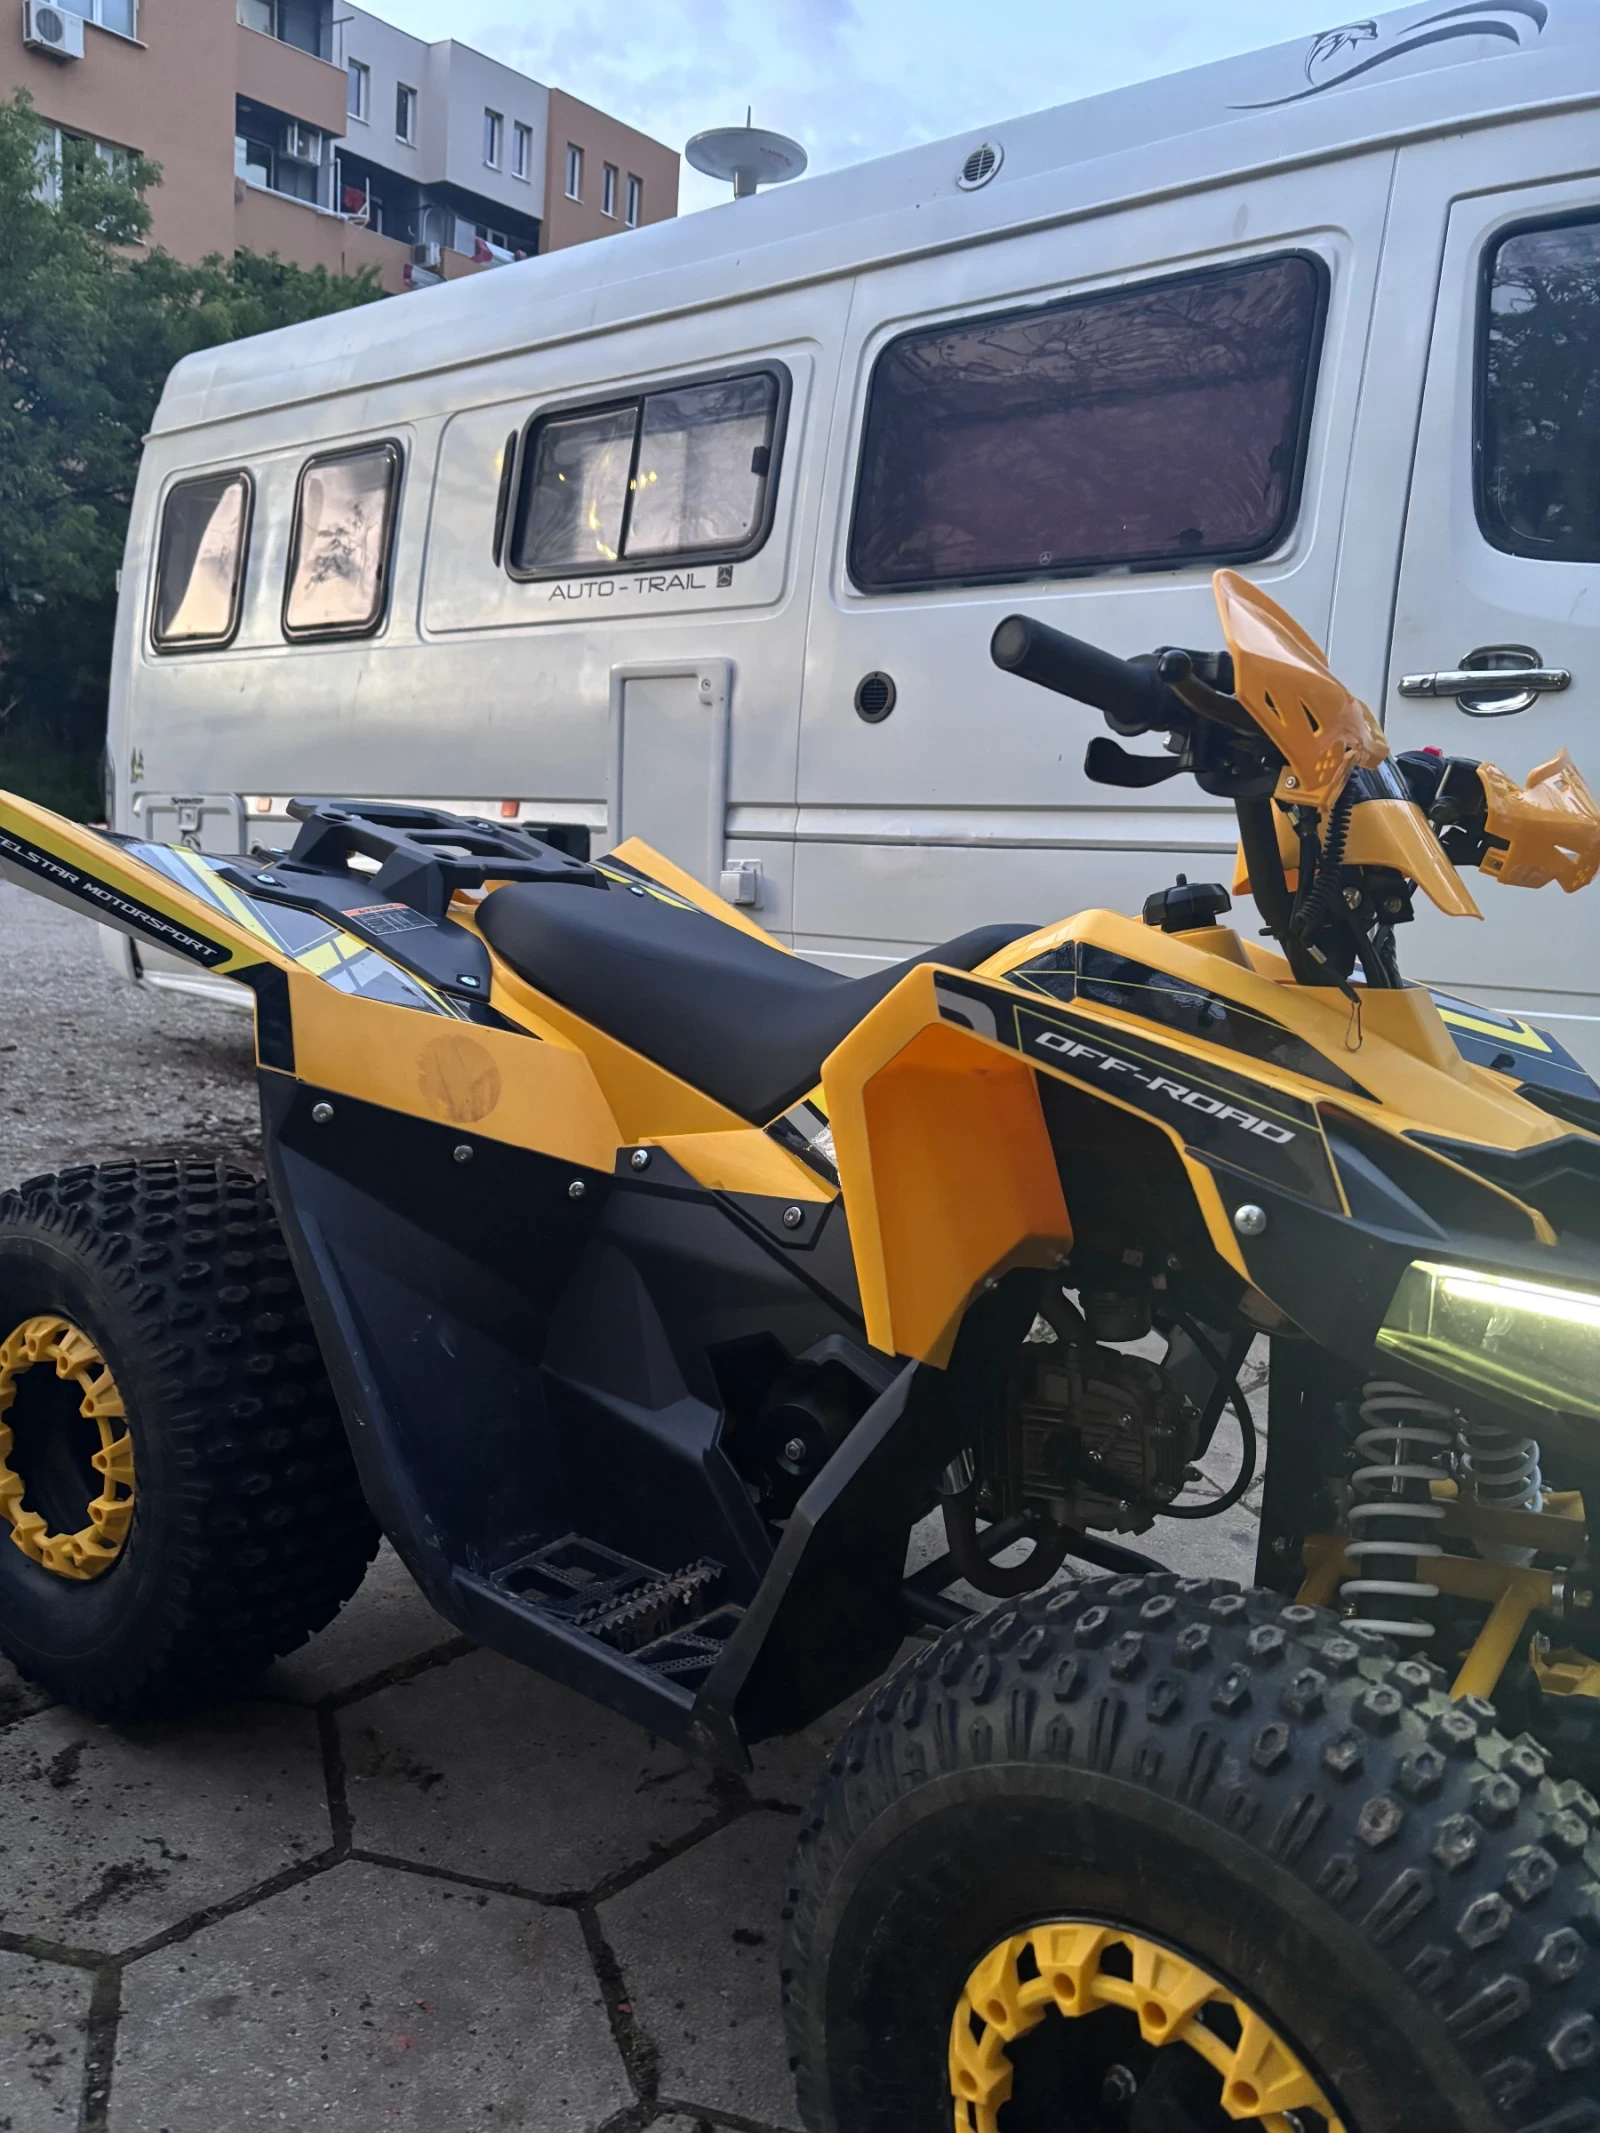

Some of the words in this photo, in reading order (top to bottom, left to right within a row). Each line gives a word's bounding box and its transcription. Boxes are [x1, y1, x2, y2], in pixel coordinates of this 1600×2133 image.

[548, 581, 614, 601] AUTO
[634, 573, 706, 593] TRAIL
[82, 883, 218, 956] MOTORSPORT
[1035, 1032, 1296, 1144] OFF-ROAD
